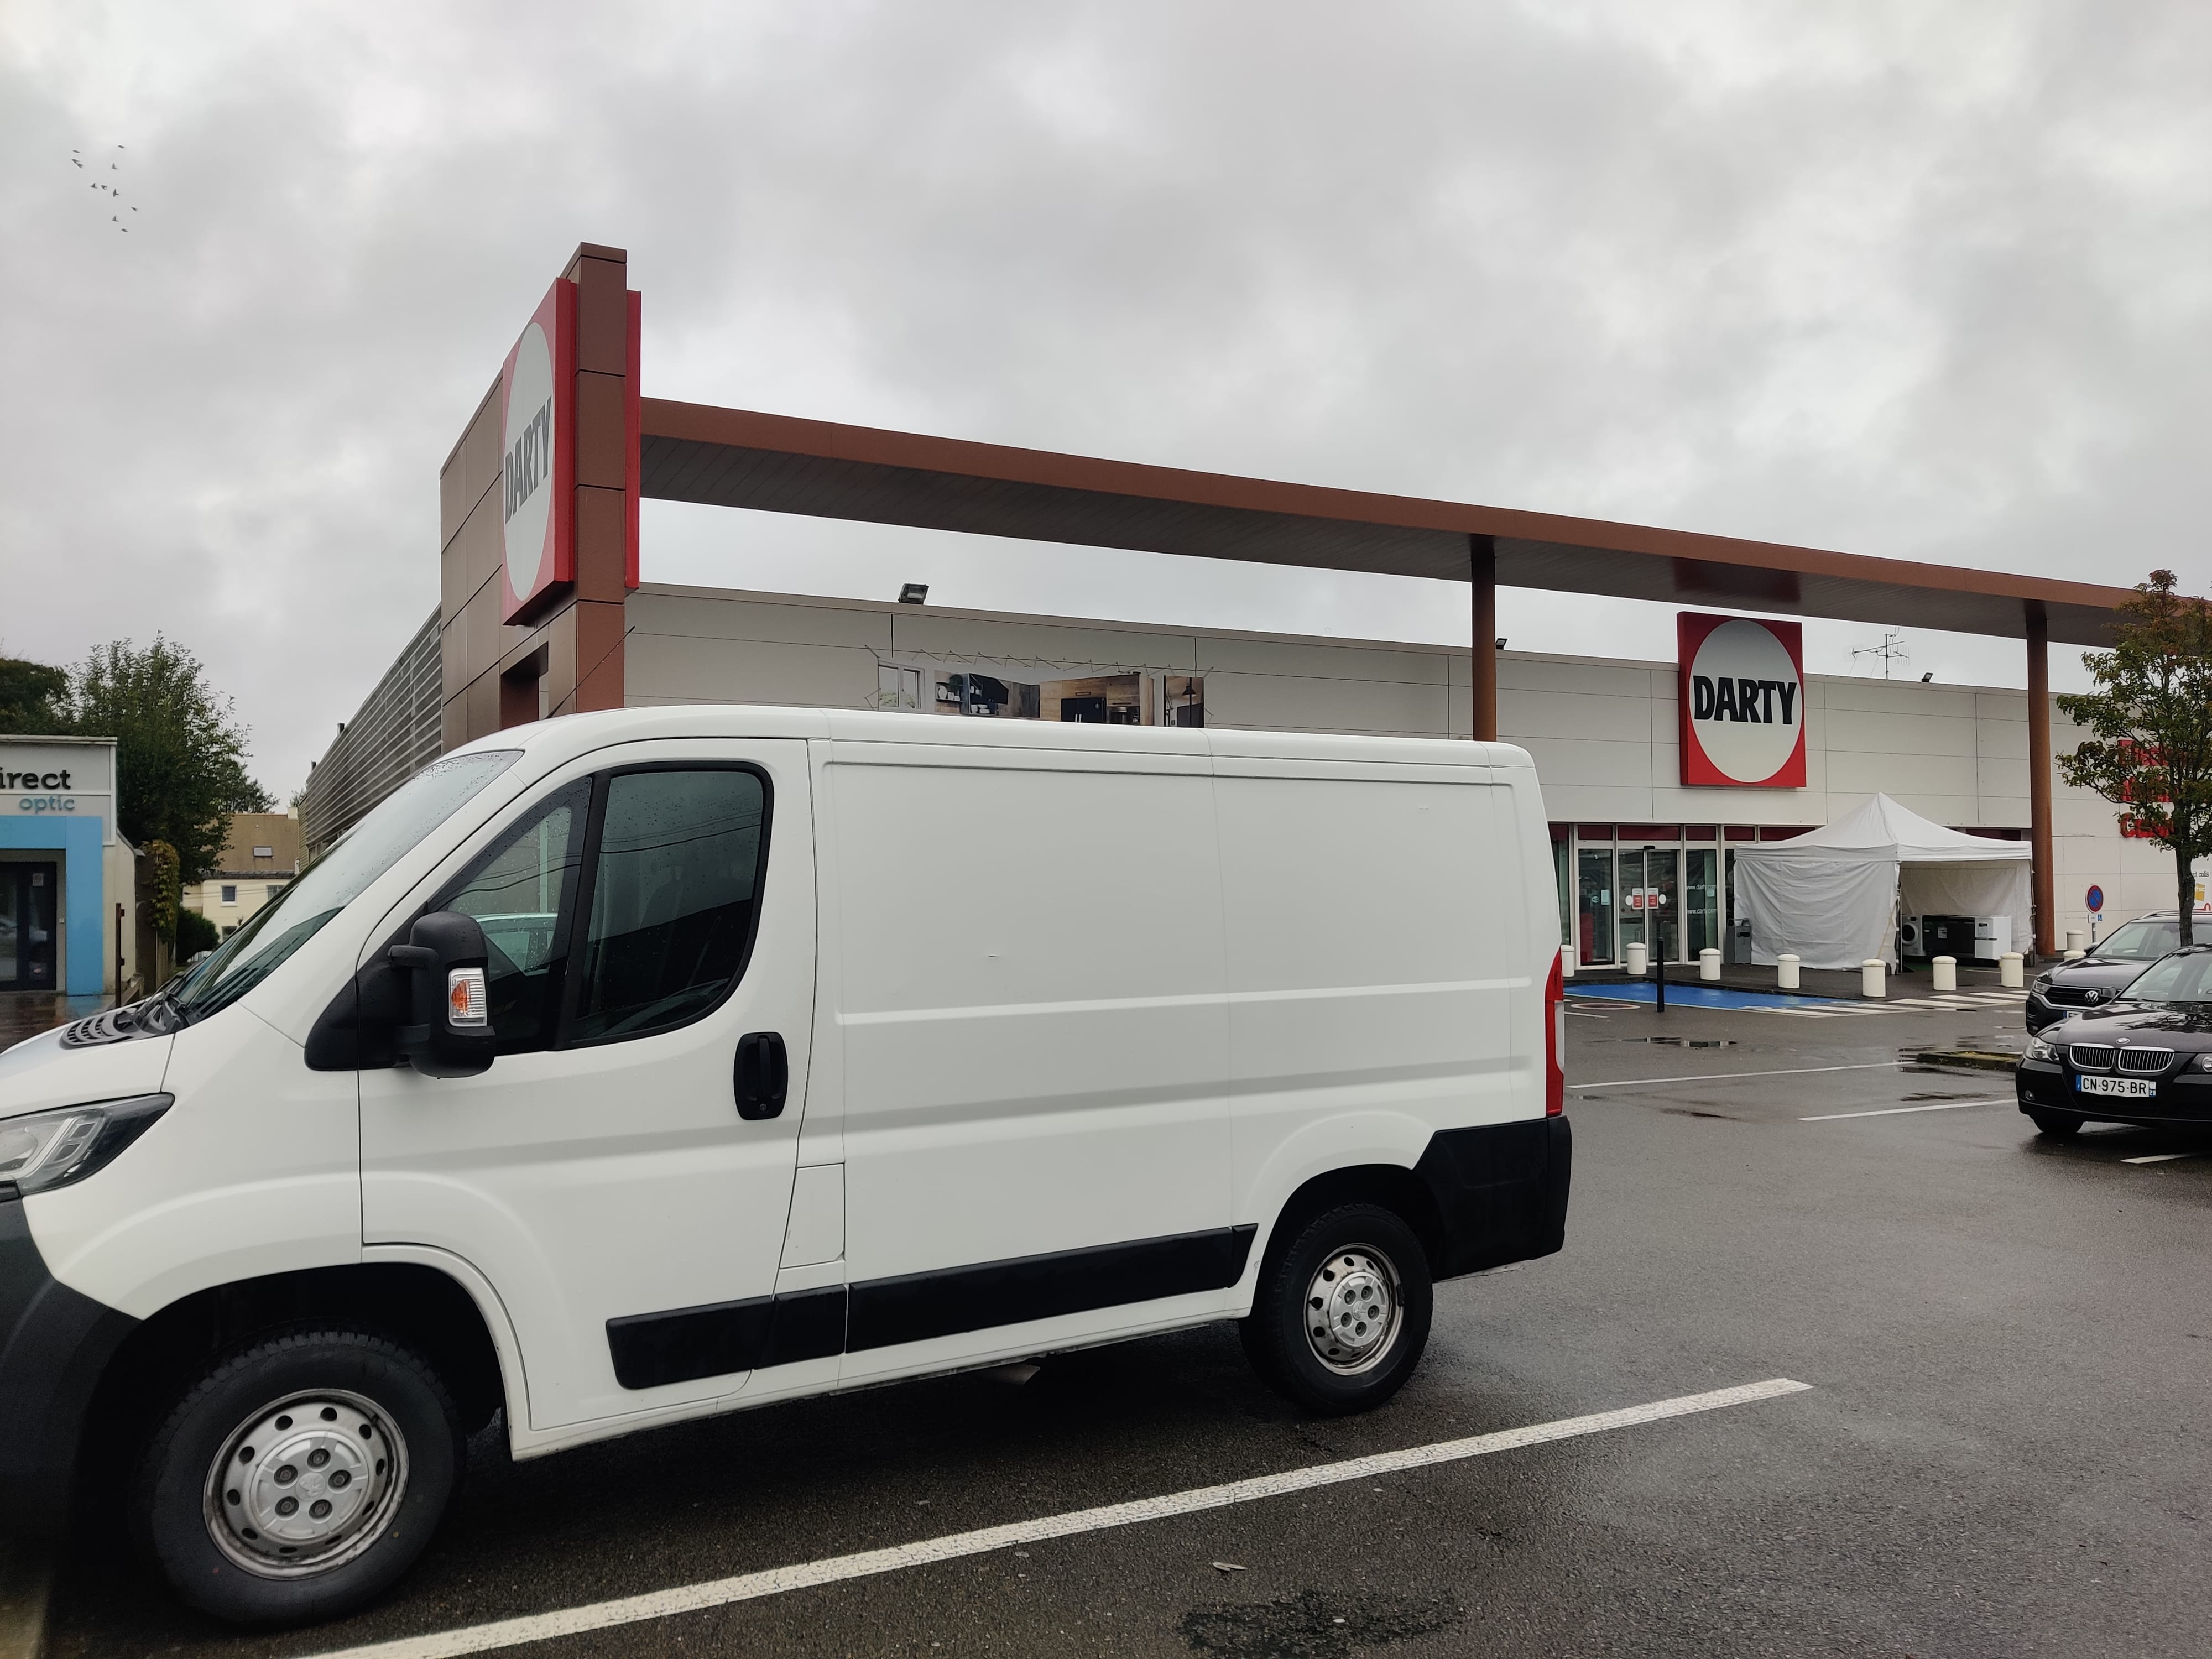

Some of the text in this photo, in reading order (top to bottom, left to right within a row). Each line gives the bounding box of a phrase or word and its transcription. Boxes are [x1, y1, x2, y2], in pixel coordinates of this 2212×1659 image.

[505, 395, 552, 525] DARTY
[1693, 675, 1797, 724] DARTY
[19, 795, 75, 814] optic
[2083, 1078, 2146, 1095] CN-975-BR
